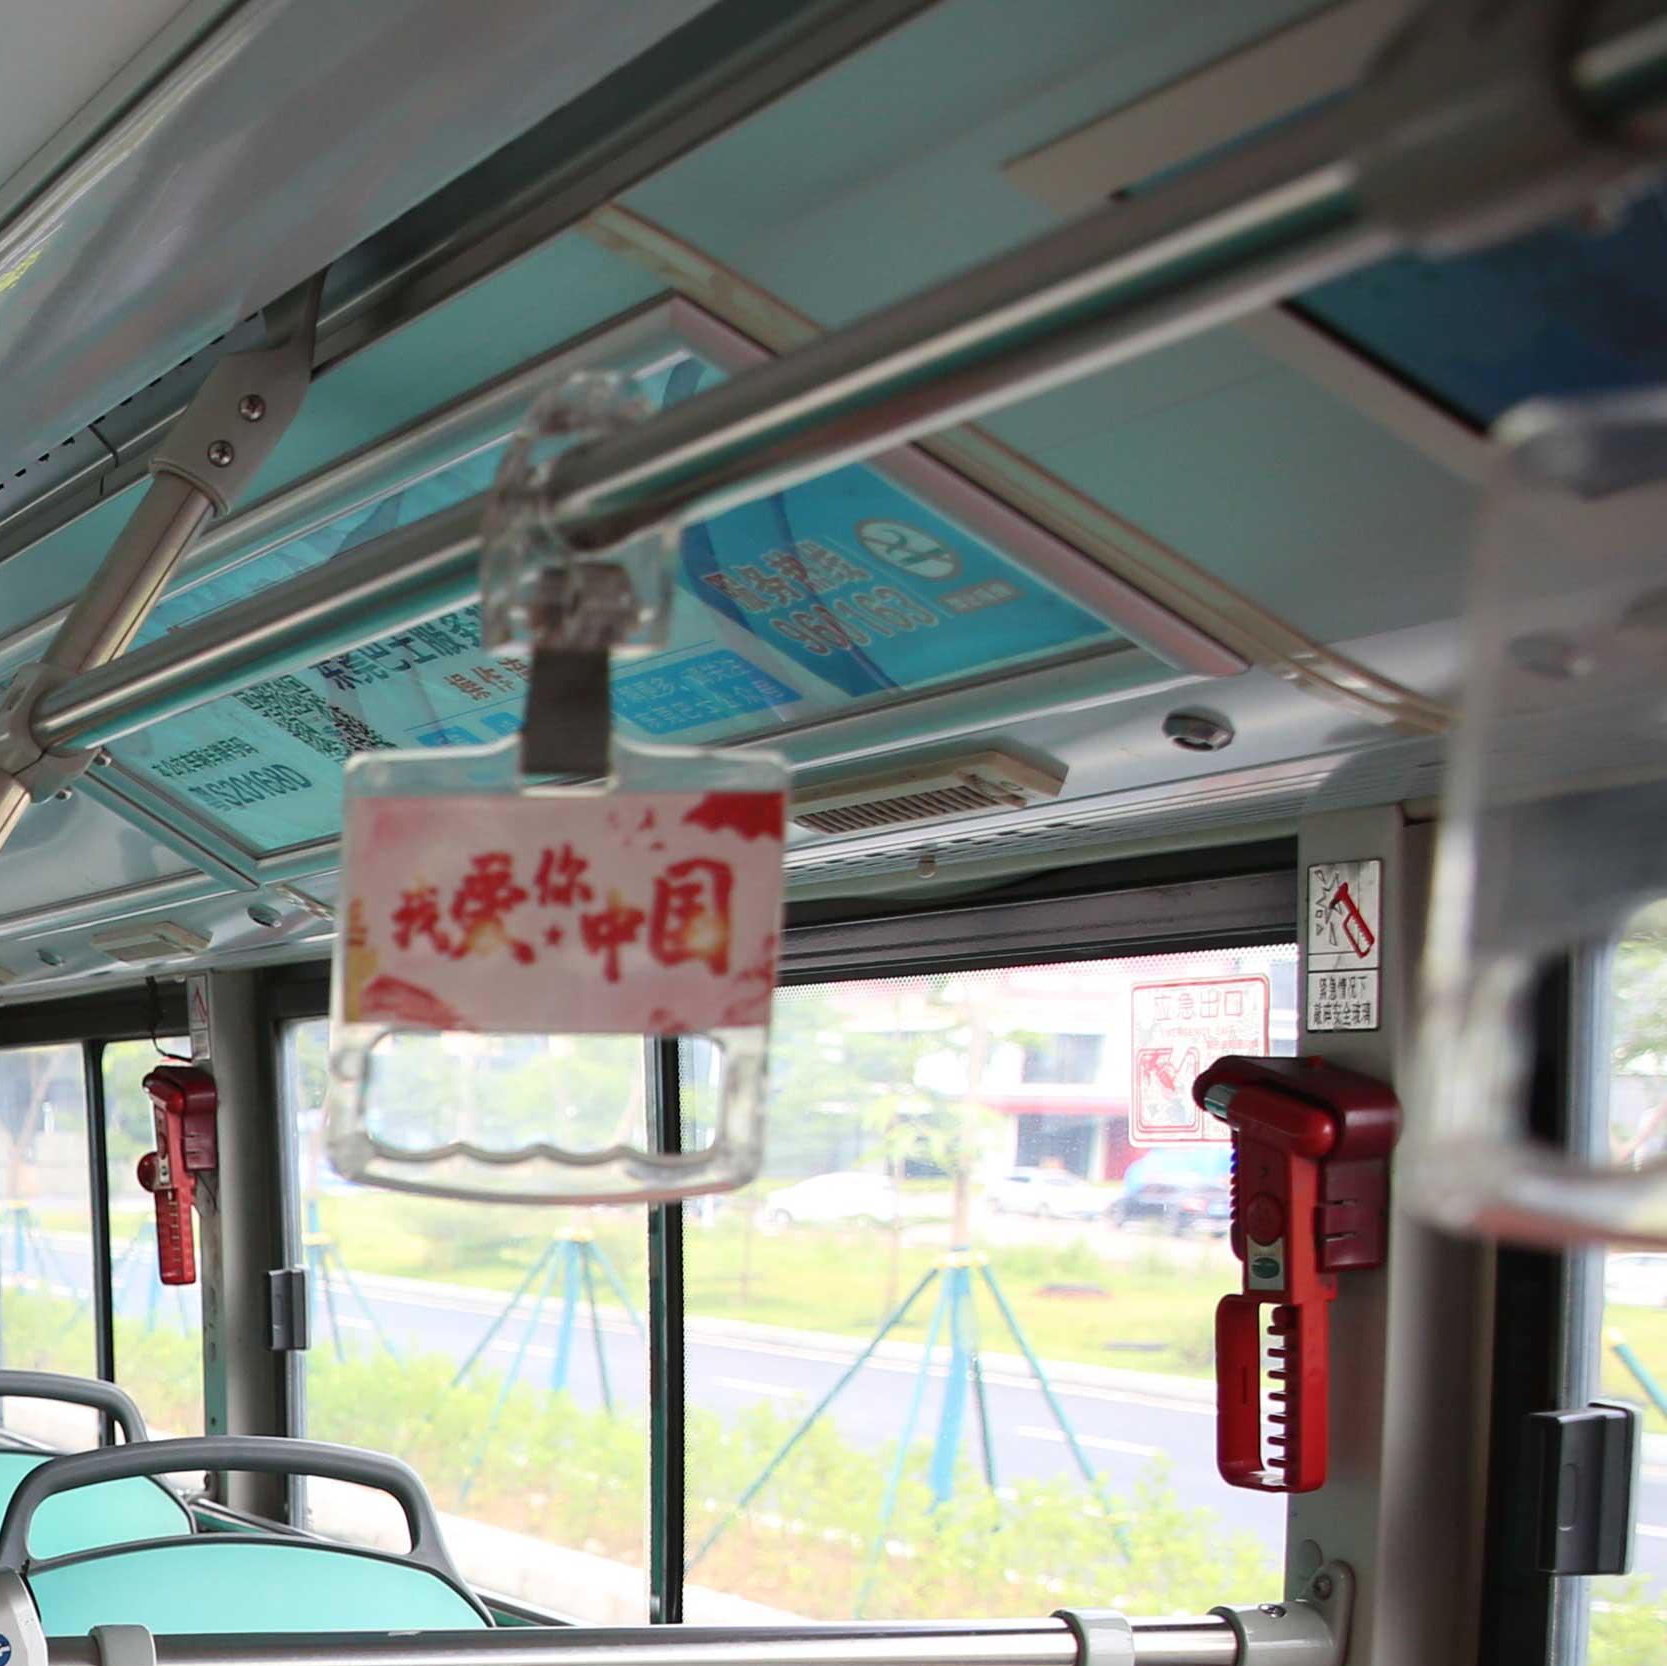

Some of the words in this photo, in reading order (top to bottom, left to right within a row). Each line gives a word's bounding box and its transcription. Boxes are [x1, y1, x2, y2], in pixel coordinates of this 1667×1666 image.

[703, 539, 873, 613] 服务热线
[308, 603, 483, 691] 东莞巴士服务
[769, 584, 938, 657] 960163
[392, 843, 734, 984] 我爱你中国
